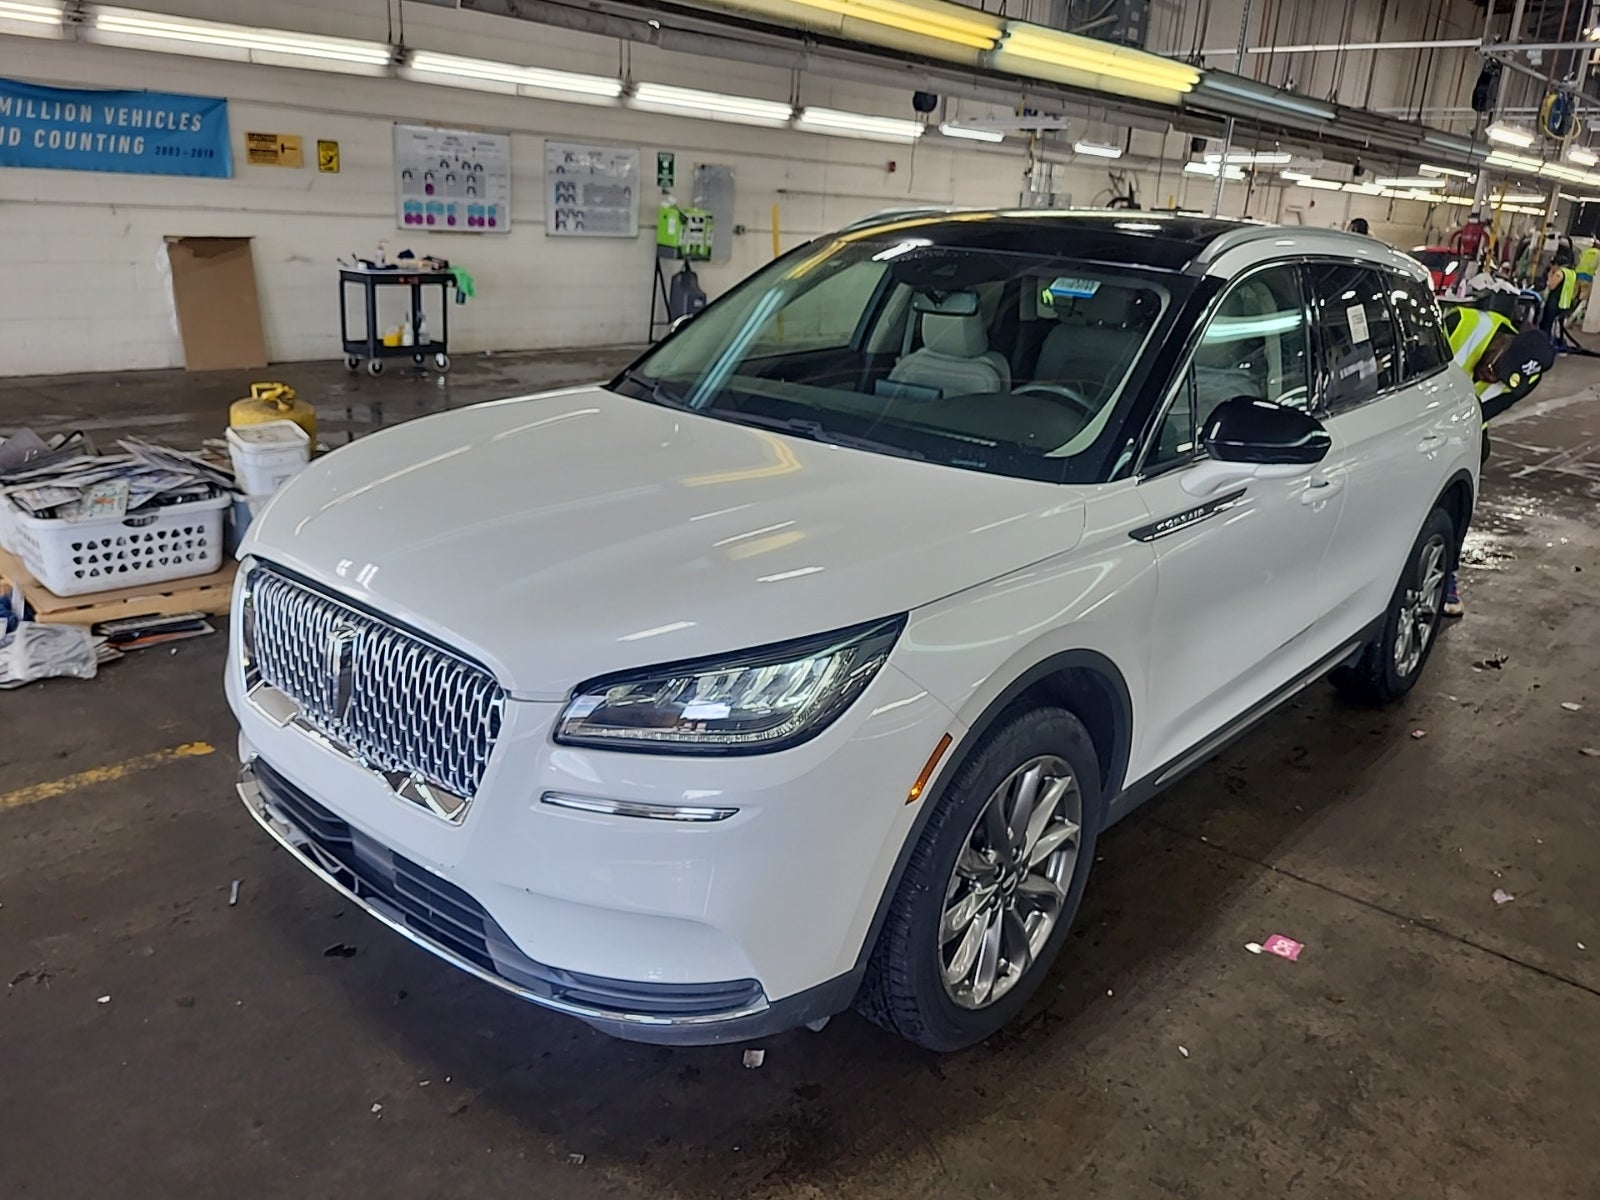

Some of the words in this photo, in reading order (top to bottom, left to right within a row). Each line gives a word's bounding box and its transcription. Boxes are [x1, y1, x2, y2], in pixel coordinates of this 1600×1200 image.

[0, 96, 92, 124] MILLION
[104, 106, 202, 132] VEHICLES
[34, 128, 145, 155] COUNTING
